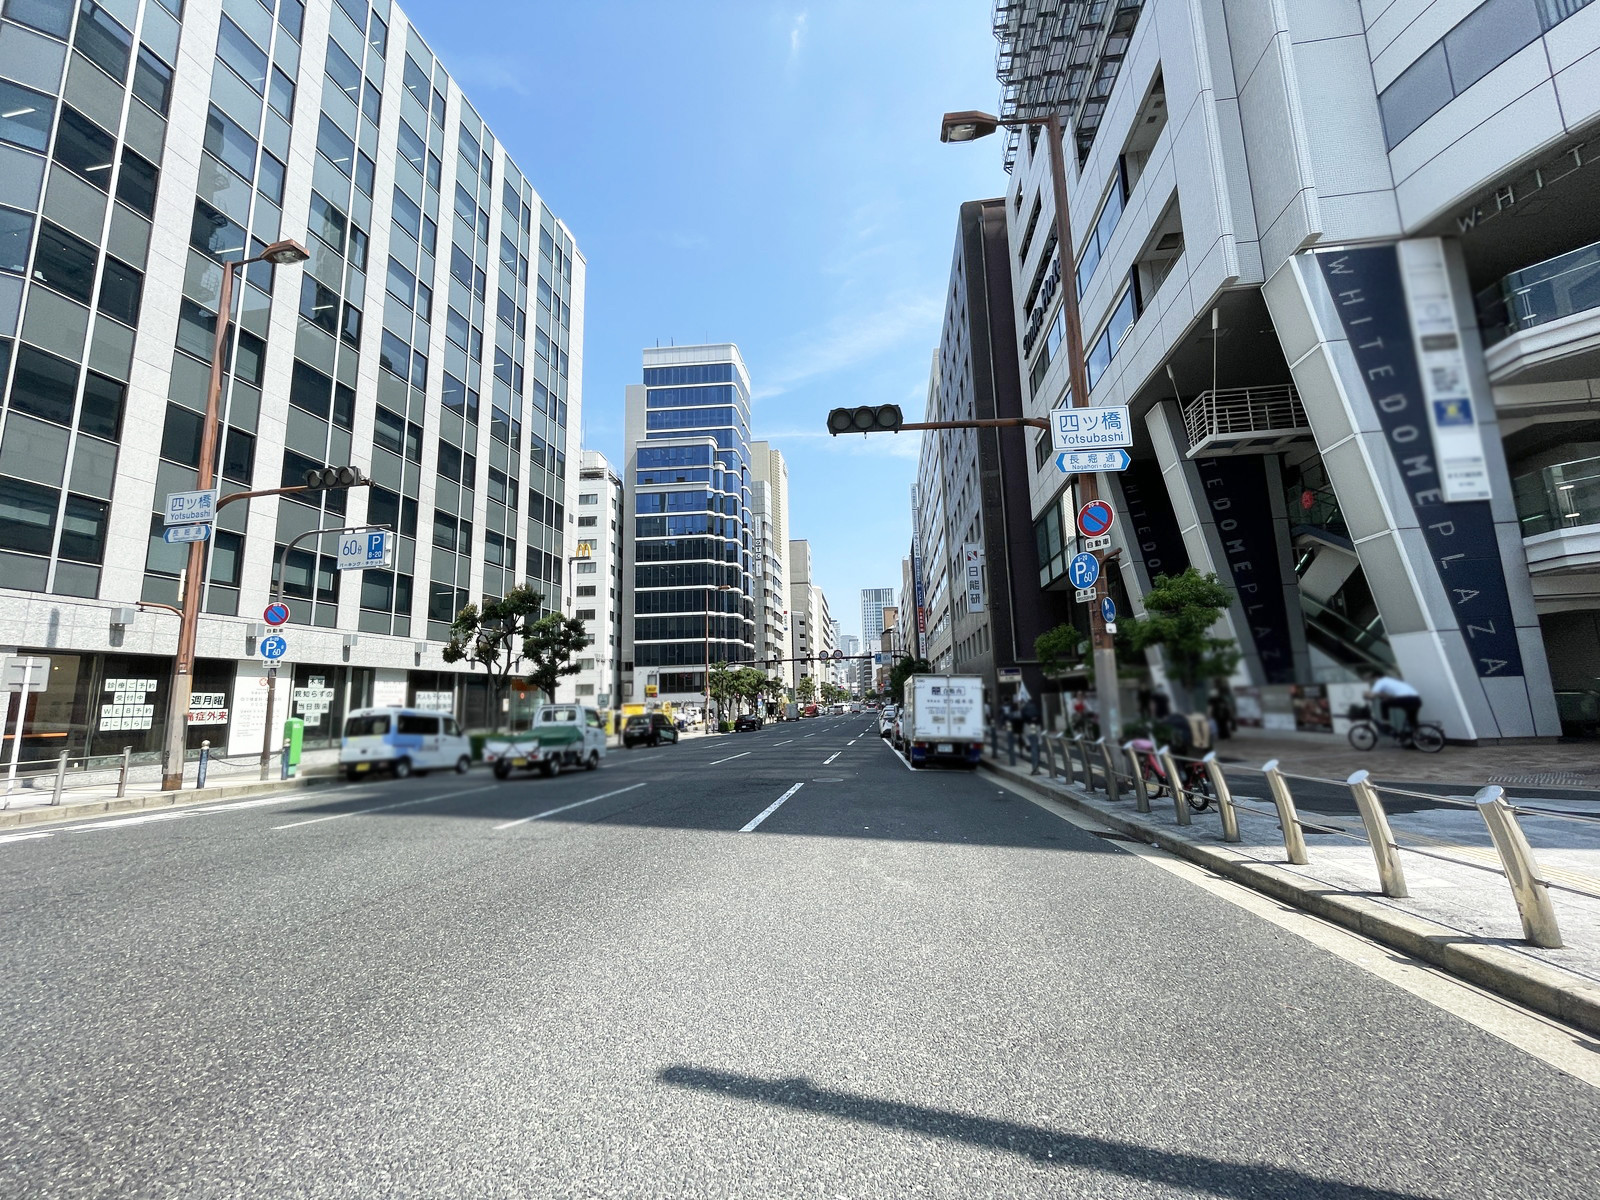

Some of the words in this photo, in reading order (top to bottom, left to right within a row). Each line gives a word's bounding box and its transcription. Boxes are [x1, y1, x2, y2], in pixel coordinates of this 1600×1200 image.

[1059, 411, 1122, 433] 四ツ橋
[1061, 431, 1124, 445] Yotsubashi
[1070, 452, 1116, 465] 長堀通
[171, 494, 212, 512] 四ツ橋
[170, 509, 211, 520] Yotsubashi
[371, 535, 381, 550] P
[1075, 561, 1087, 585] P
[969, 566, 981, 604] 日能研
[265, 640, 277, 657] P
[115, 694, 144, 702] 受付中
[294, 690, 333, 698] 親知らずの
